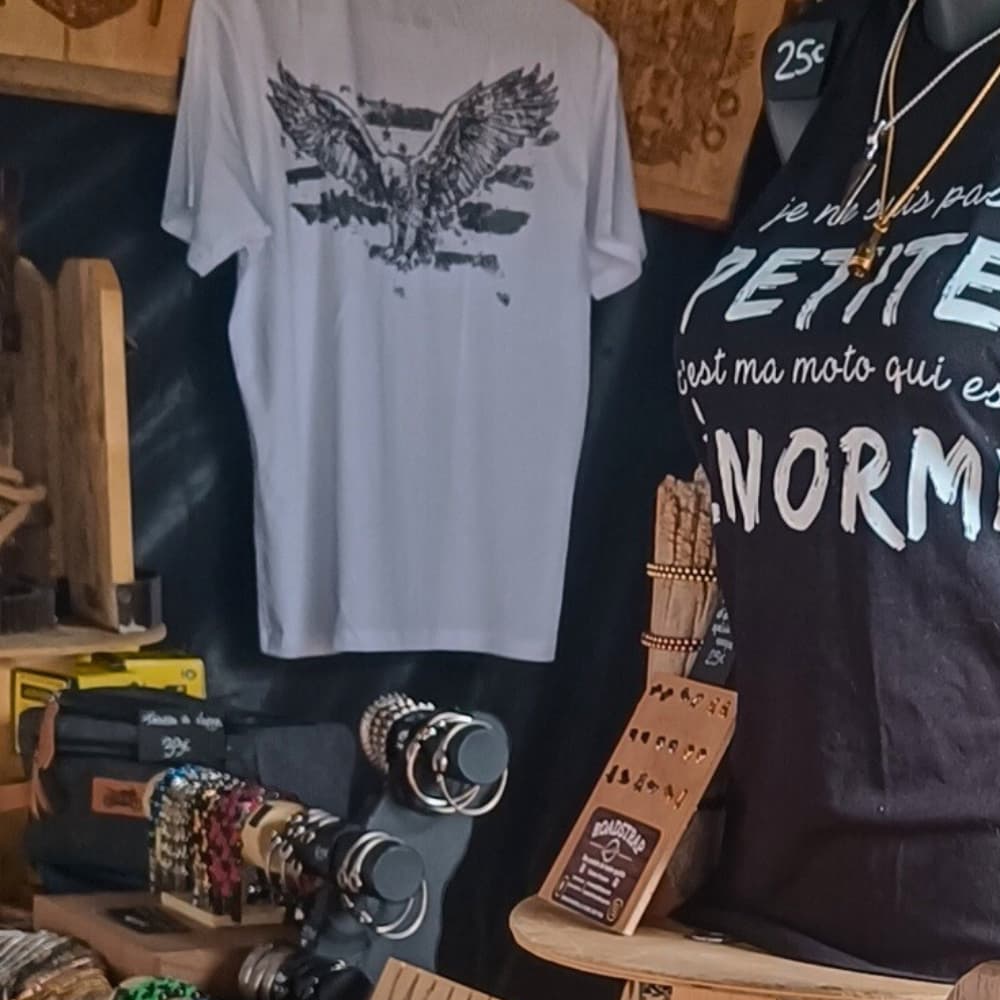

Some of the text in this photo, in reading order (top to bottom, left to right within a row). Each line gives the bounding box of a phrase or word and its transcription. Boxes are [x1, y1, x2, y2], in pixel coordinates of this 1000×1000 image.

[759, 197, 808, 232] je
[734, 355, 785, 385] ma
[792, 344, 876, 385] moto
[885, 354, 952, 394] qui
